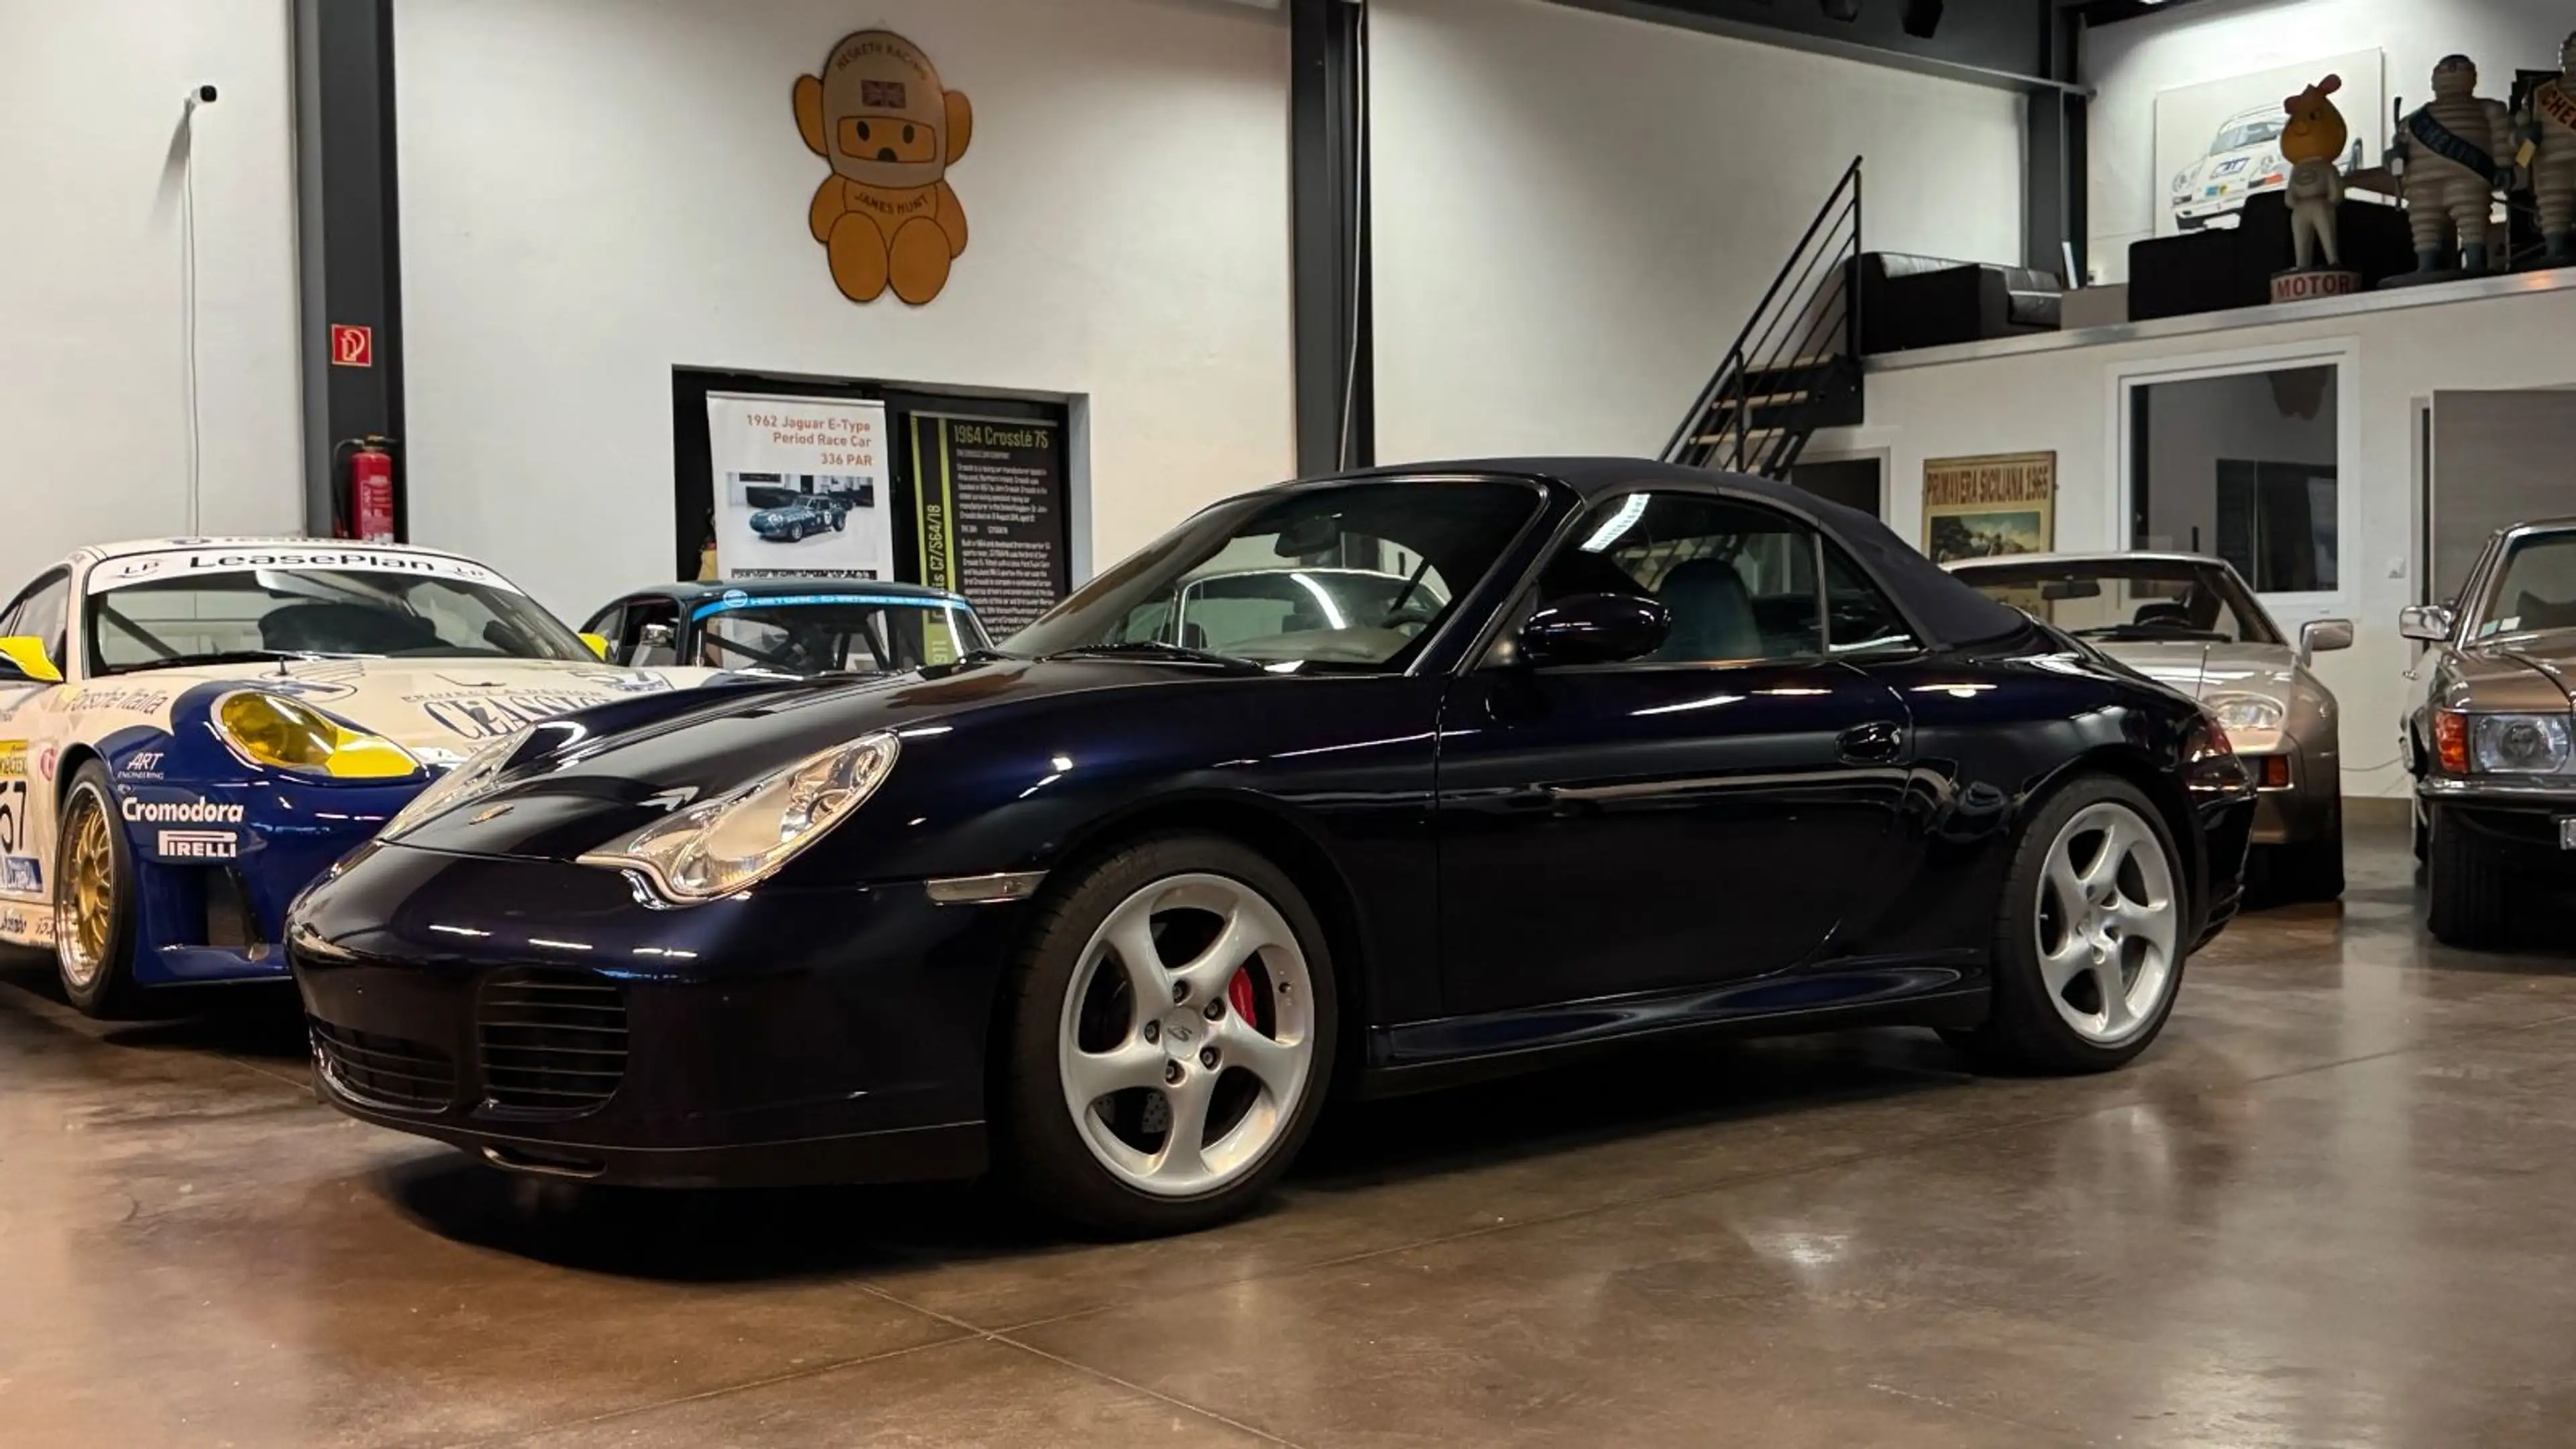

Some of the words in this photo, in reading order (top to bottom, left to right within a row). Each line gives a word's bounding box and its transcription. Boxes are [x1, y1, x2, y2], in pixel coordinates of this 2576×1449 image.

[853, 192, 894, 215] JAMES
[2277, 274, 2351, 297] MOTOR
[747, 414, 777, 428] 1962
[782, 417, 824, 431] Jaguar
[828, 418, 871, 435] E-Type
[773, 432, 814, 445] Period
[818, 435, 847, 447] Race
[851, 435, 871, 447] Car
[820, 453, 843, 466] 336
[847, 455, 873, 467] PAR
[190, 555, 435, 570] LeasePlan
[933, 640, 949, 663] 911
[127, 752, 164, 770] ART
[122, 796, 244, 822] Cromodora
[158, 830, 237, 857] PIRELLI
